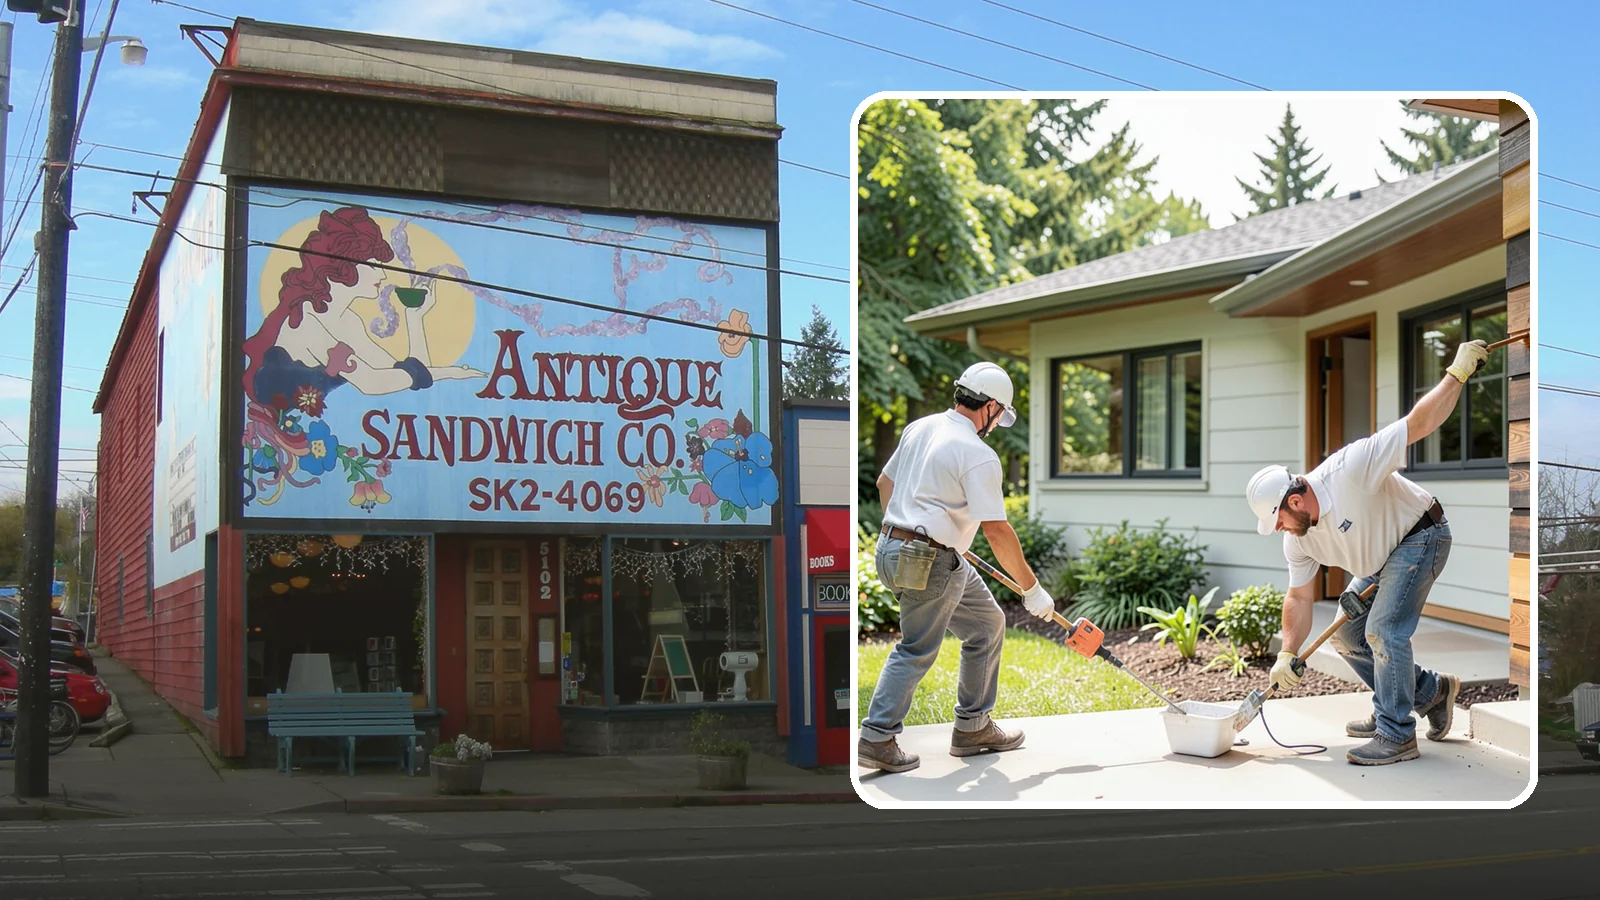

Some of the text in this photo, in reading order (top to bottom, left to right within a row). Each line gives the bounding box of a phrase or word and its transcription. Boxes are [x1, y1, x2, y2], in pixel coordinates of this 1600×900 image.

[361, 408, 684, 469] SANDWICH CO.
[468, 478, 646, 513] SK2-4069
[540, 541, 551, 600] 5102
[809, 555, 835, 569] BOOKS
